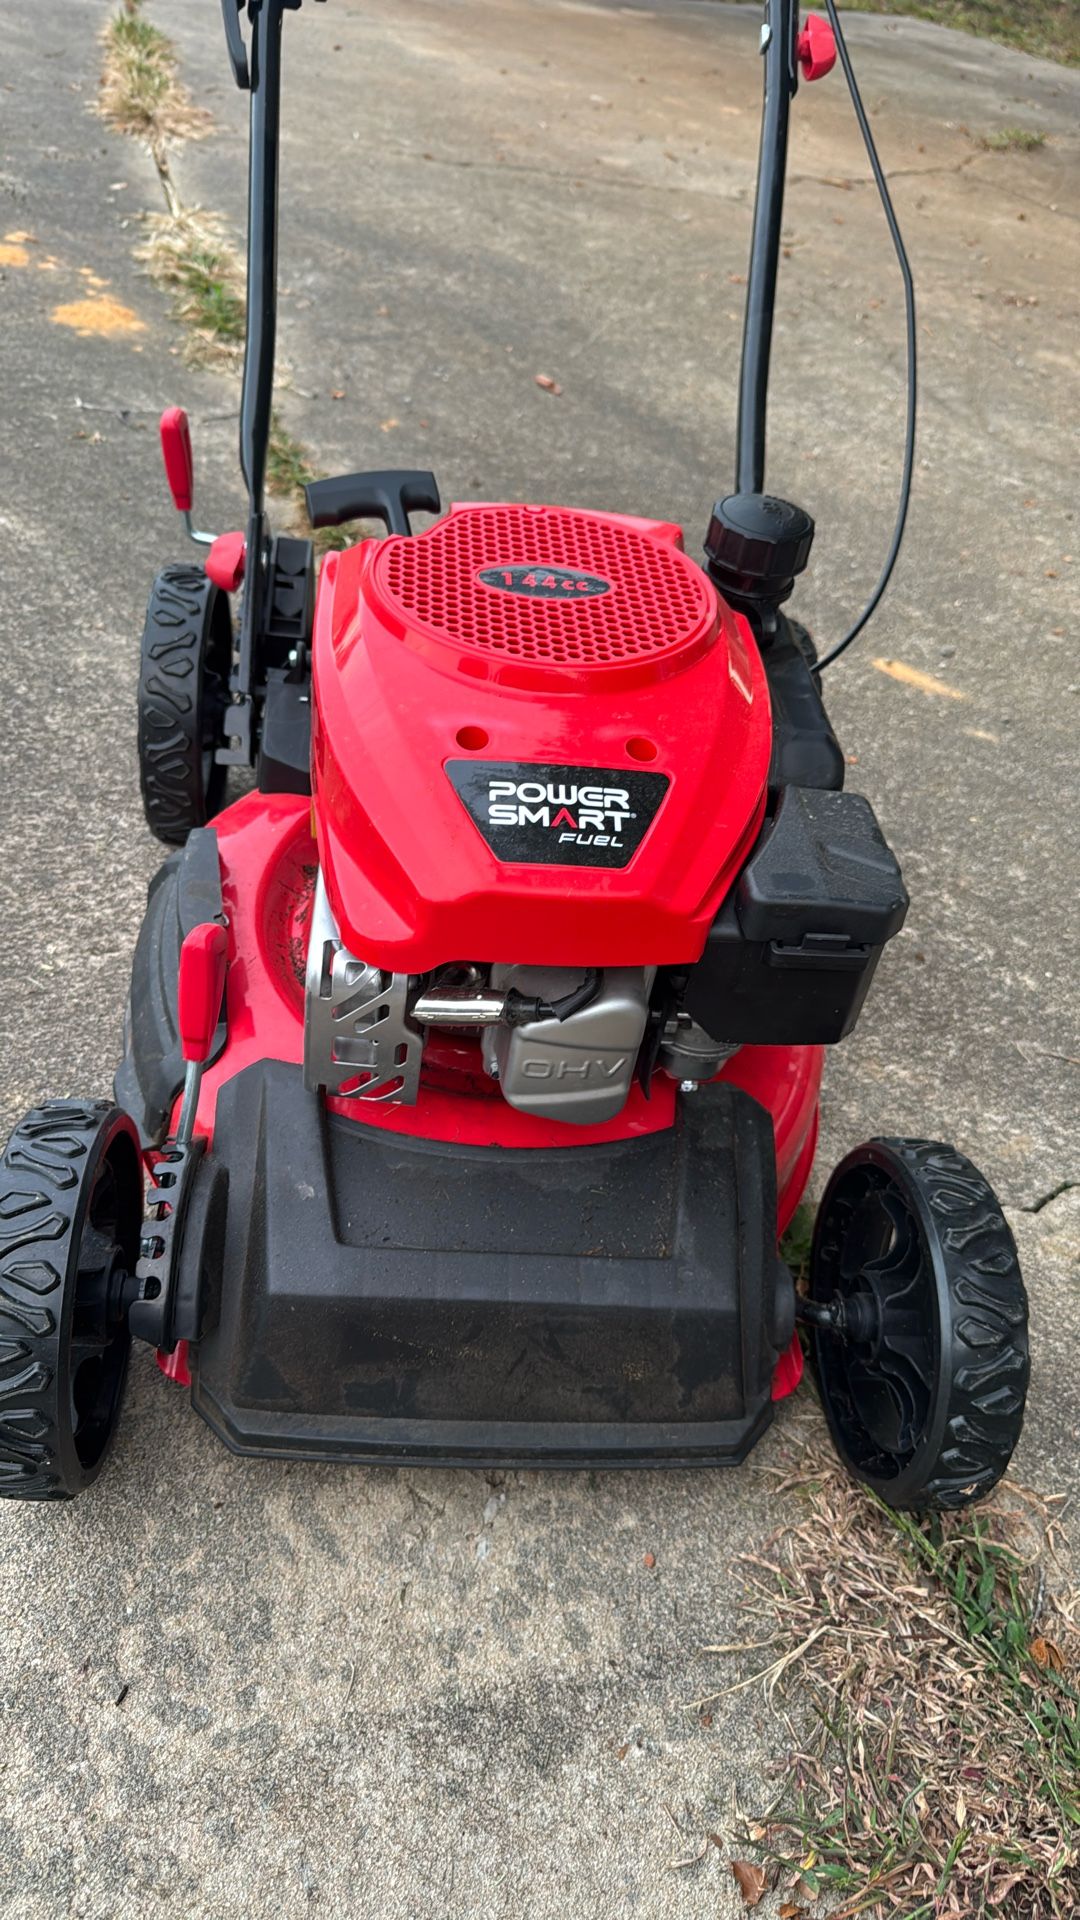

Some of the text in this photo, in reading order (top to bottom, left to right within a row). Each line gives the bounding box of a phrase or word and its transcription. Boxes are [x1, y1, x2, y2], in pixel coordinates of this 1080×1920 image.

[501, 572, 589, 591] 144cc
[488, 781, 630, 810] POWER
[488, 804, 631, 831] SMART
[522, 1057, 627, 1079] OHV
